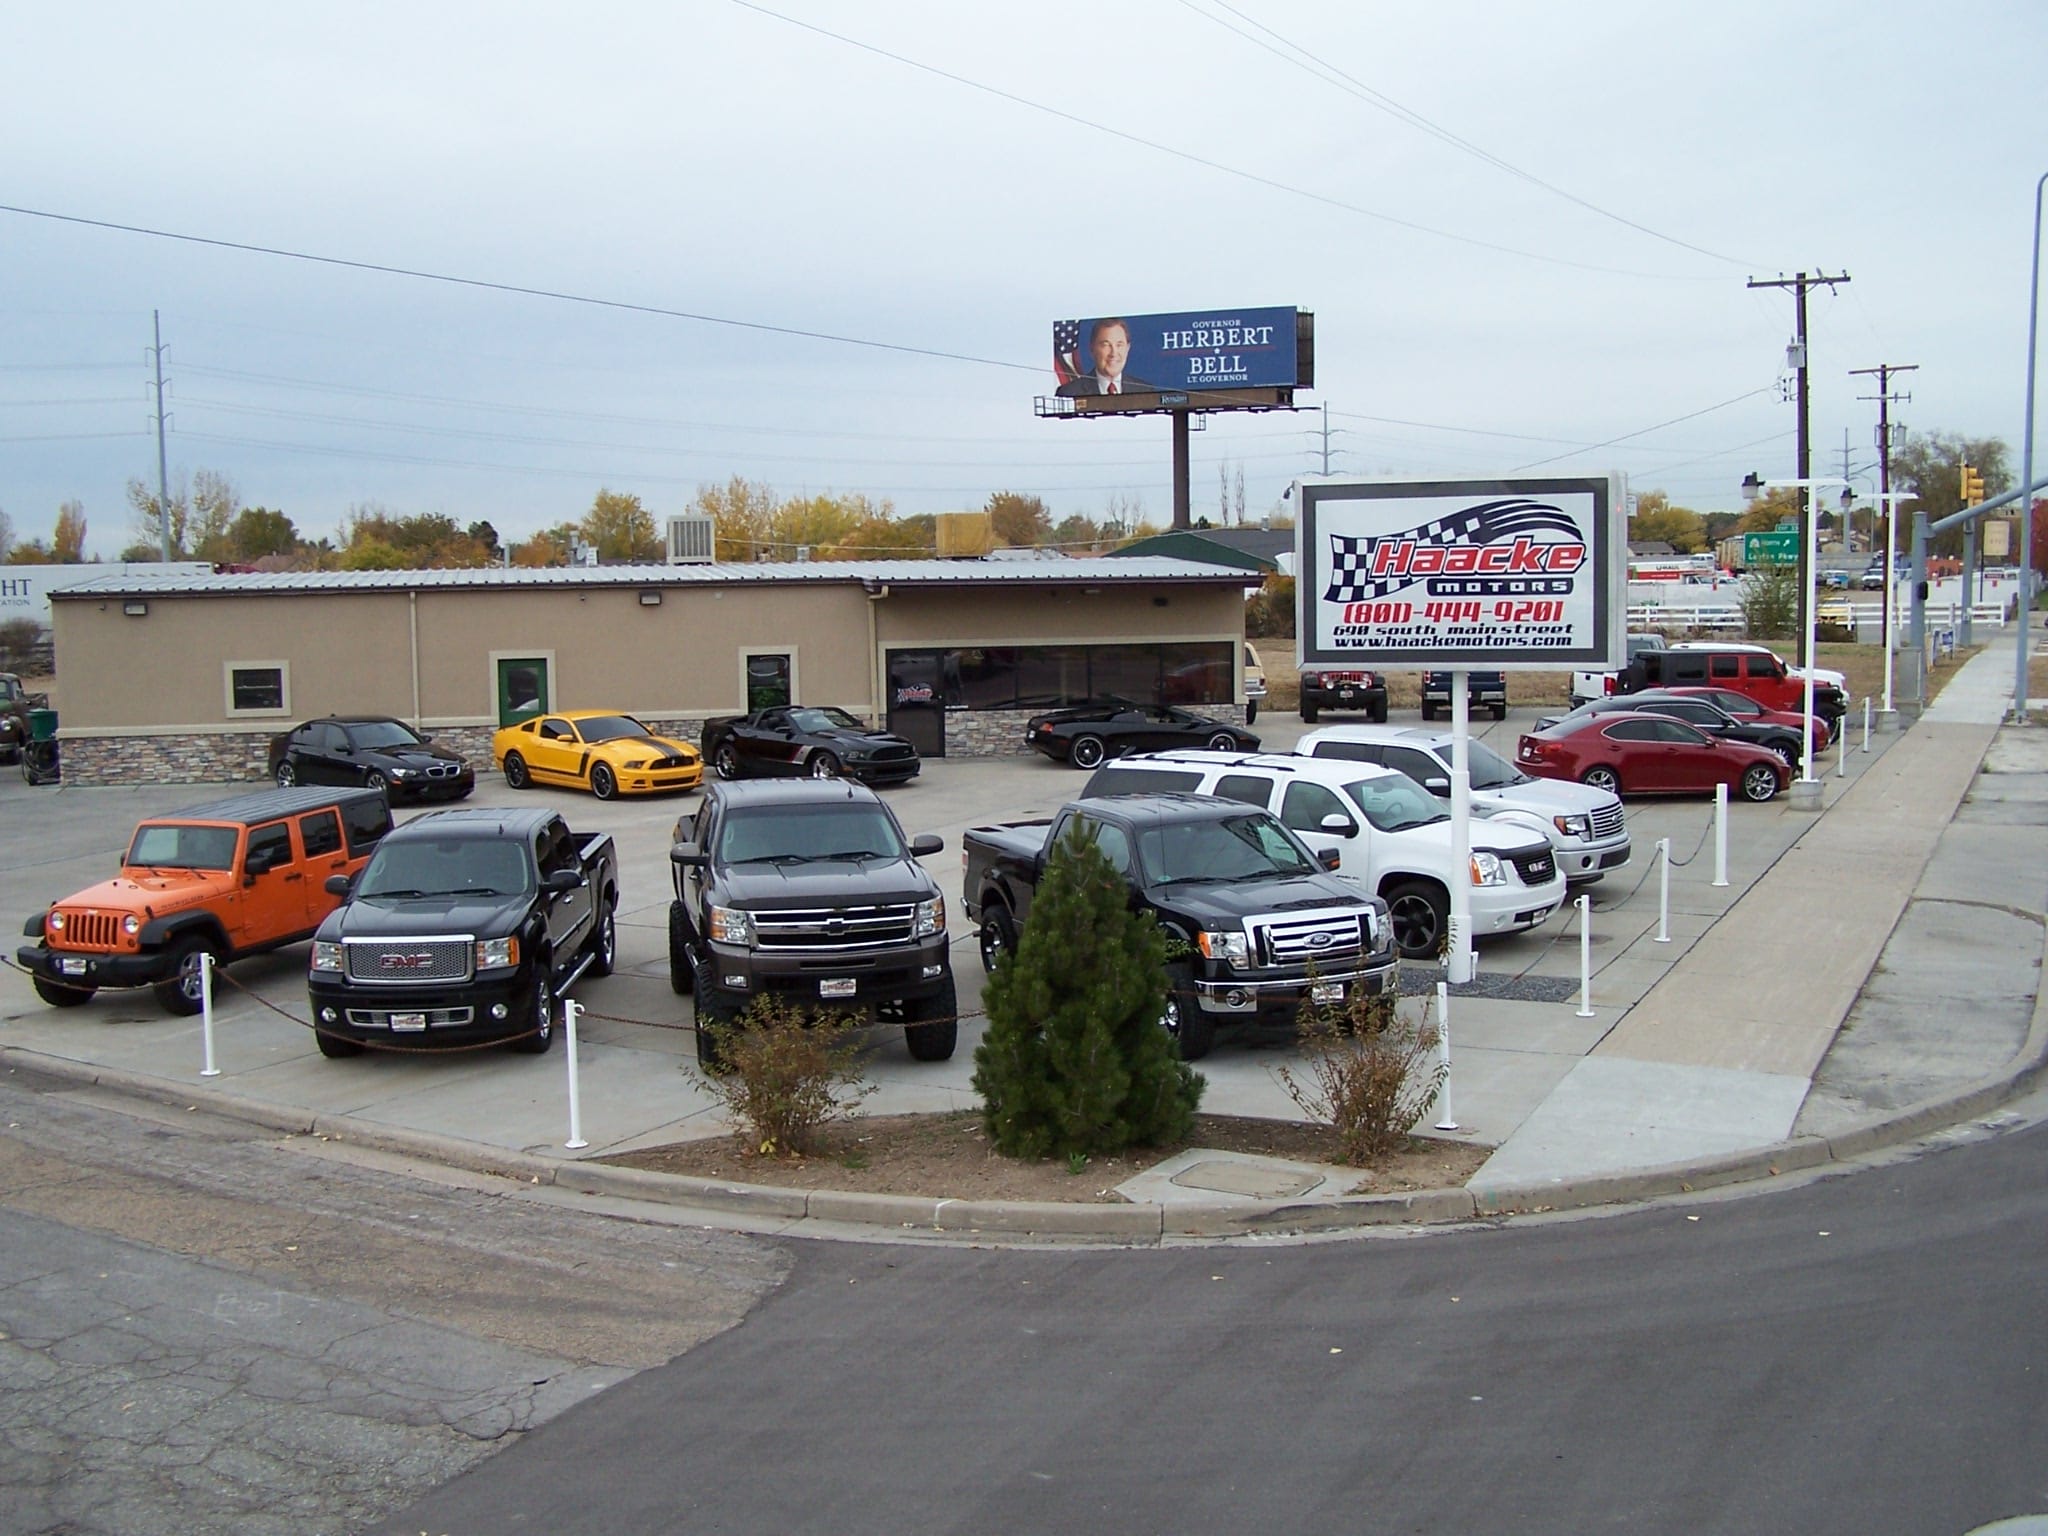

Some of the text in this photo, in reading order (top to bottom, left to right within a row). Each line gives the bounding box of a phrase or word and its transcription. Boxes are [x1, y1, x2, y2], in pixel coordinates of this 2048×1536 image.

[1192, 319, 1241, 329] GOVERNOR
[1162, 326, 1274, 350] HERBERT
[1189, 355, 1247, 375] BELL
[1199, 373, 1248, 383] GOVERNOR
[1371, 536, 1586, 577] Haacke
[1436, 581, 1568, 593] MOTORS
[1344, 600, 1564, 624] (801)-444-9201
[1333, 622, 1573, 636] 698 south main street
[1334, 634, 1572, 648] www.haackemotors.com
[380, 953, 433, 969] GMC
